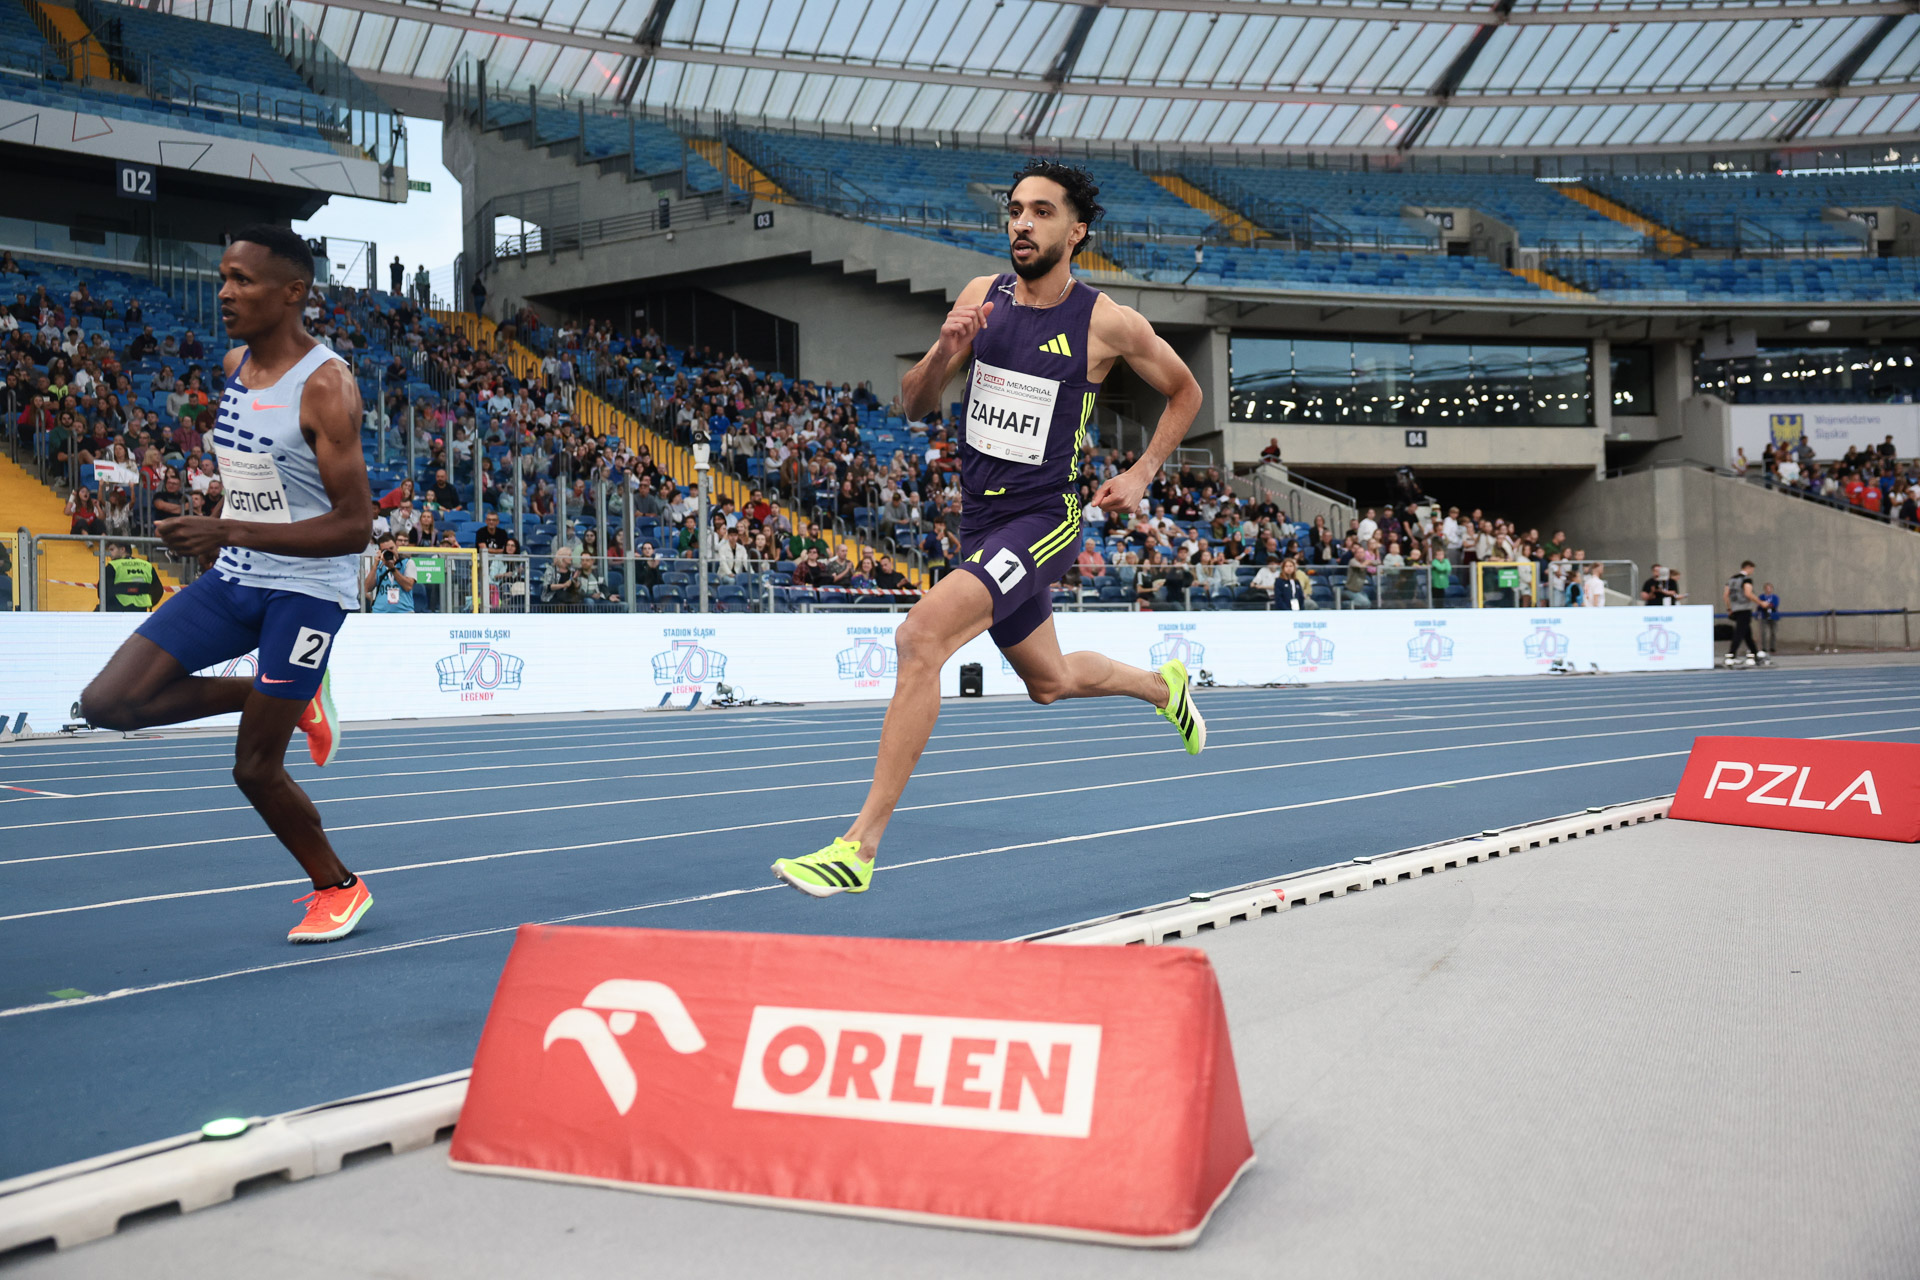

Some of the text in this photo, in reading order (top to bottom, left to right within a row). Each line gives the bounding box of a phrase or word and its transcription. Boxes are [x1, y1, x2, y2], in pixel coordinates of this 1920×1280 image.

[123, 168, 151, 195] 02
[758, 214, 770, 227] 03
[1006, 380, 1052, 396] MEMORIAŁ
[970, 399, 1040, 437] ZAHAFI
[426, 572, 432, 582] 2
[998, 560, 1020, 584] 1
[450, 628, 510, 641] STADION ŚLĄSKI
[664, 626, 716, 638] STADION ŚLĄSKI
[298, 634, 324, 665] 2
[854, 637, 886, 678] 70
[1298, 631, 1322, 664] 70
[460, 642, 502, 690] 70
[672, 640, 708, 683] 70
[461, 682, 474, 690] LAT
[672, 676, 684, 684] LAT
[672, 685, 702, 694] LEGENDY
[461, 692, 494, 702] LEGENDY
[1704, 760, 1882, 815] PZLA
[762, 1024, 1072, 1116] ORLEN
